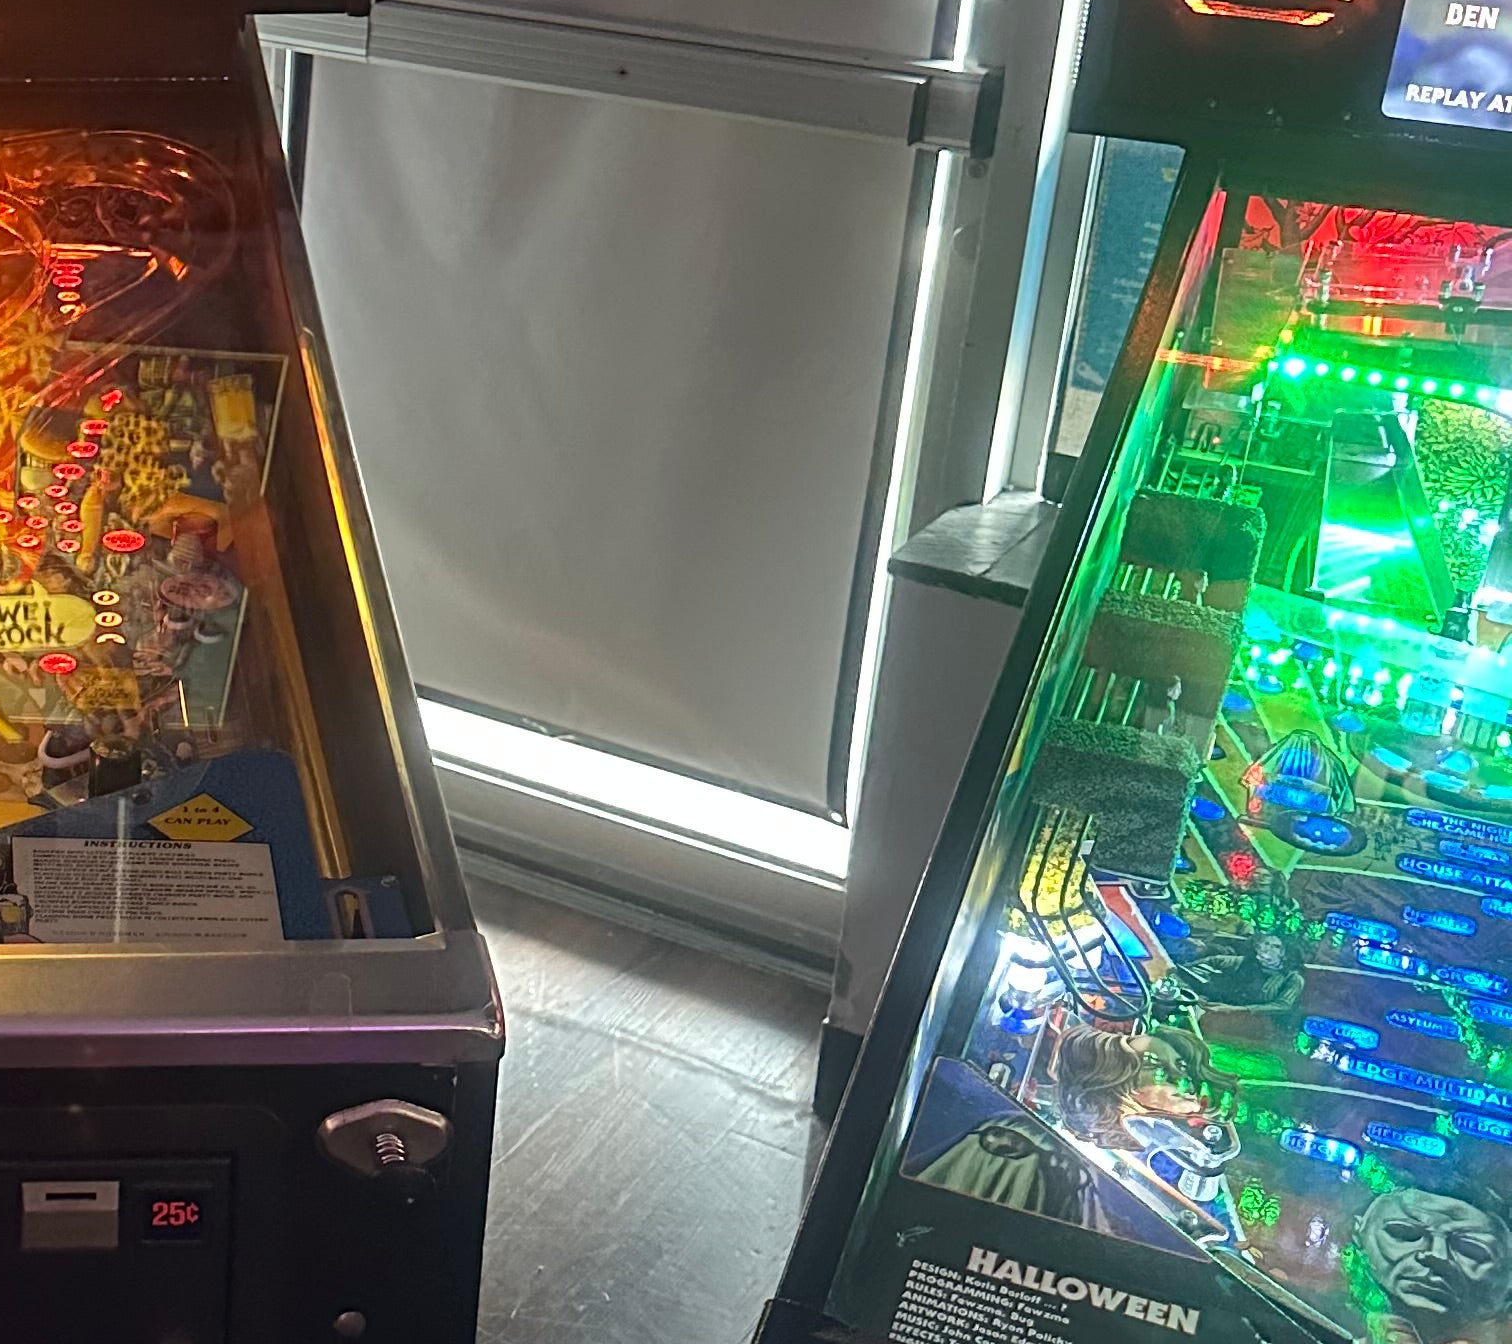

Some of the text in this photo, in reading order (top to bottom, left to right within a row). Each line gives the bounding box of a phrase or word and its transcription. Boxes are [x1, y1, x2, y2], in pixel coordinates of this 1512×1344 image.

[1405, 83, 1487, 110] REPLAY
[164, 817, 232, 827] CAN PLAY
[83, 839, 192, 850] INSTRUCTIONS
[1402, 856, 1464, 878] HOUSE
[1390, 1012, 1444, 1032] ASYLUM
[151, 1201, 200, 1227] 25¢
[912, 1259, 962, 1282] DESIGN:
[908, 1269, 1014, 1309] PROGRAMMING:
[966, 1246, 1200, 1336] HALLOWEEN
[902, 1289, 989, 1324] ANIMATIONS:
[991, 1317, 1025, 1335] Ryan
[905, 1280, 947, 1300] RULES:
[1010, 1311, 1035, 1327] Bug
[891, 1321, 946, 1344] EFFECTS:
[895, 1311, 940, 1331] MUSIC:
[941, 1325, 972, 1342] John
[898, 1300, 970, 1329] ARTWORK:
[972, 1323, 1008, 1342] Jason
